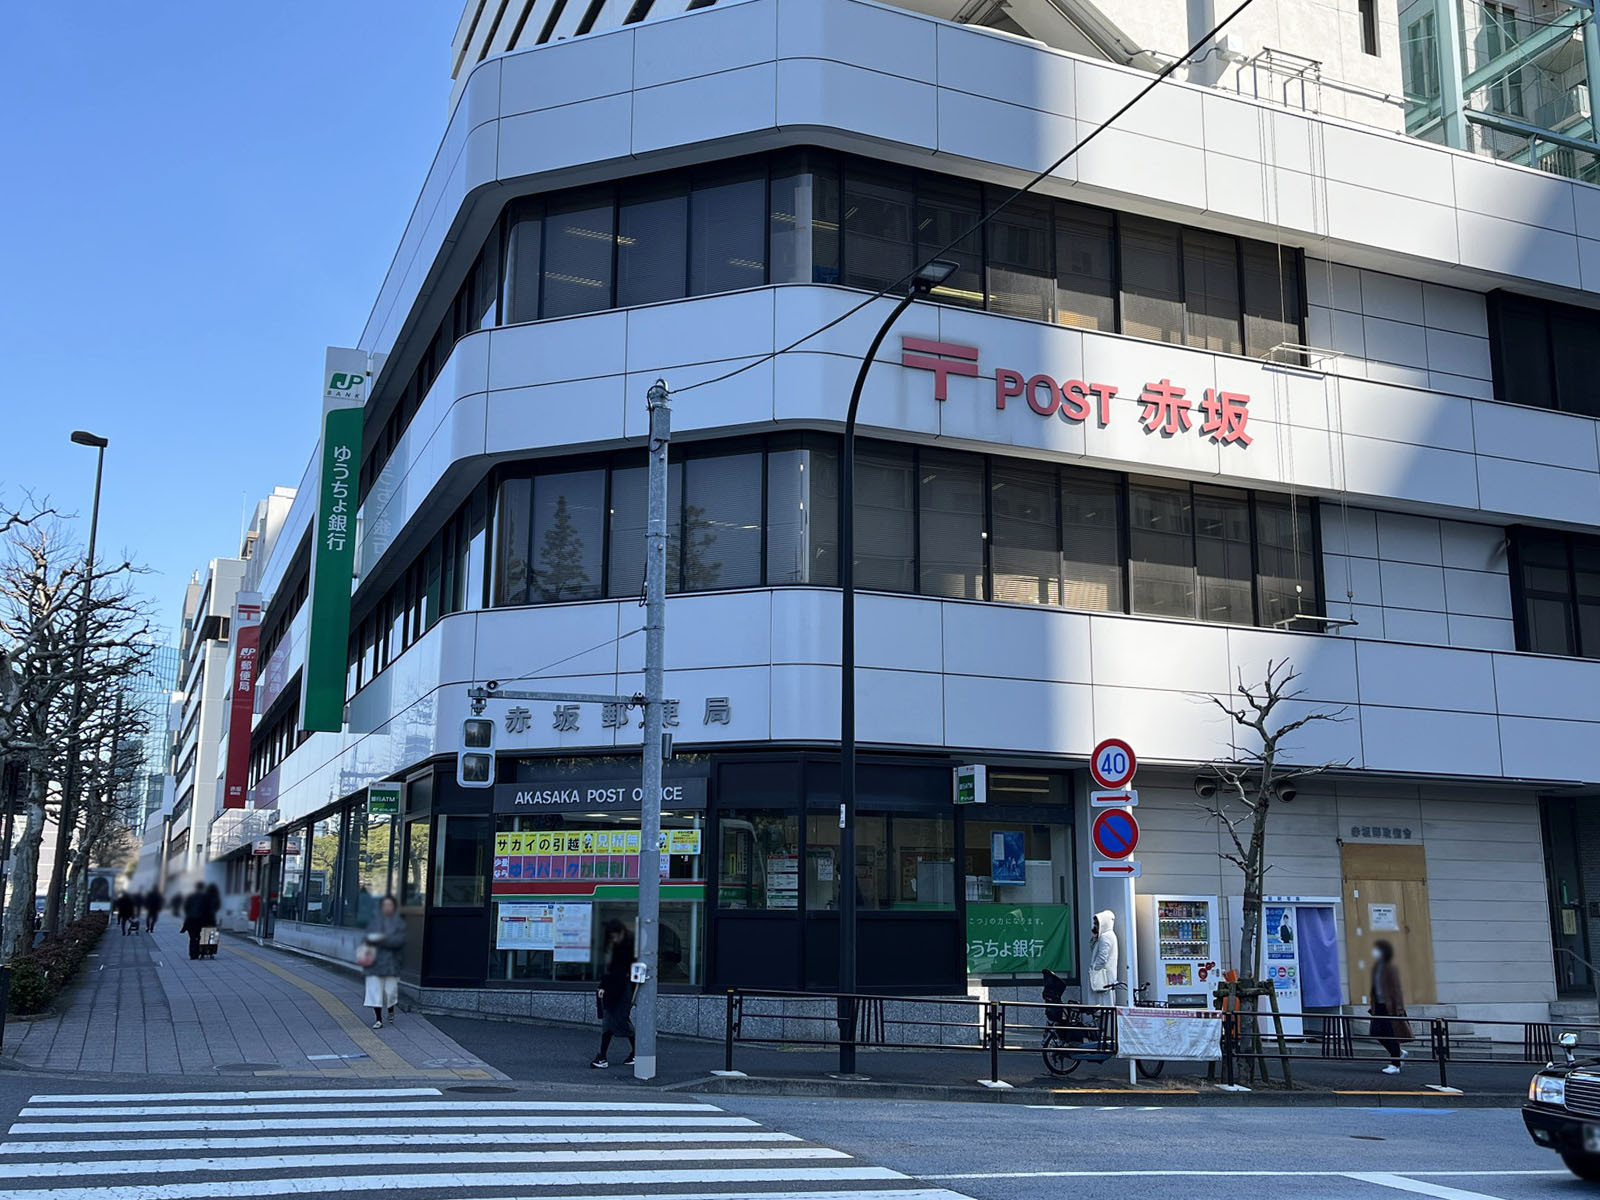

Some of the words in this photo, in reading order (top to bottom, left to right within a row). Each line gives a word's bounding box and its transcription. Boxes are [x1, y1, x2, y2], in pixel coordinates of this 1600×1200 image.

[329, 372, 364, 390] JP
[327, 391, 360, 399] BANK
[995, 368, 1118, 425] POST
[1138, 379, 1254, 446] 赤坂
[327, 445, 352, 551] ゆうちょ銀行
[1101, 752, 1125, 775] 40
[514, 789, 580, 805] AKASAKA
[587, 788, 626, 803] POST
[632, 786, 683, 801] OICE
[497, 838, 580, 852] サカイの引越
